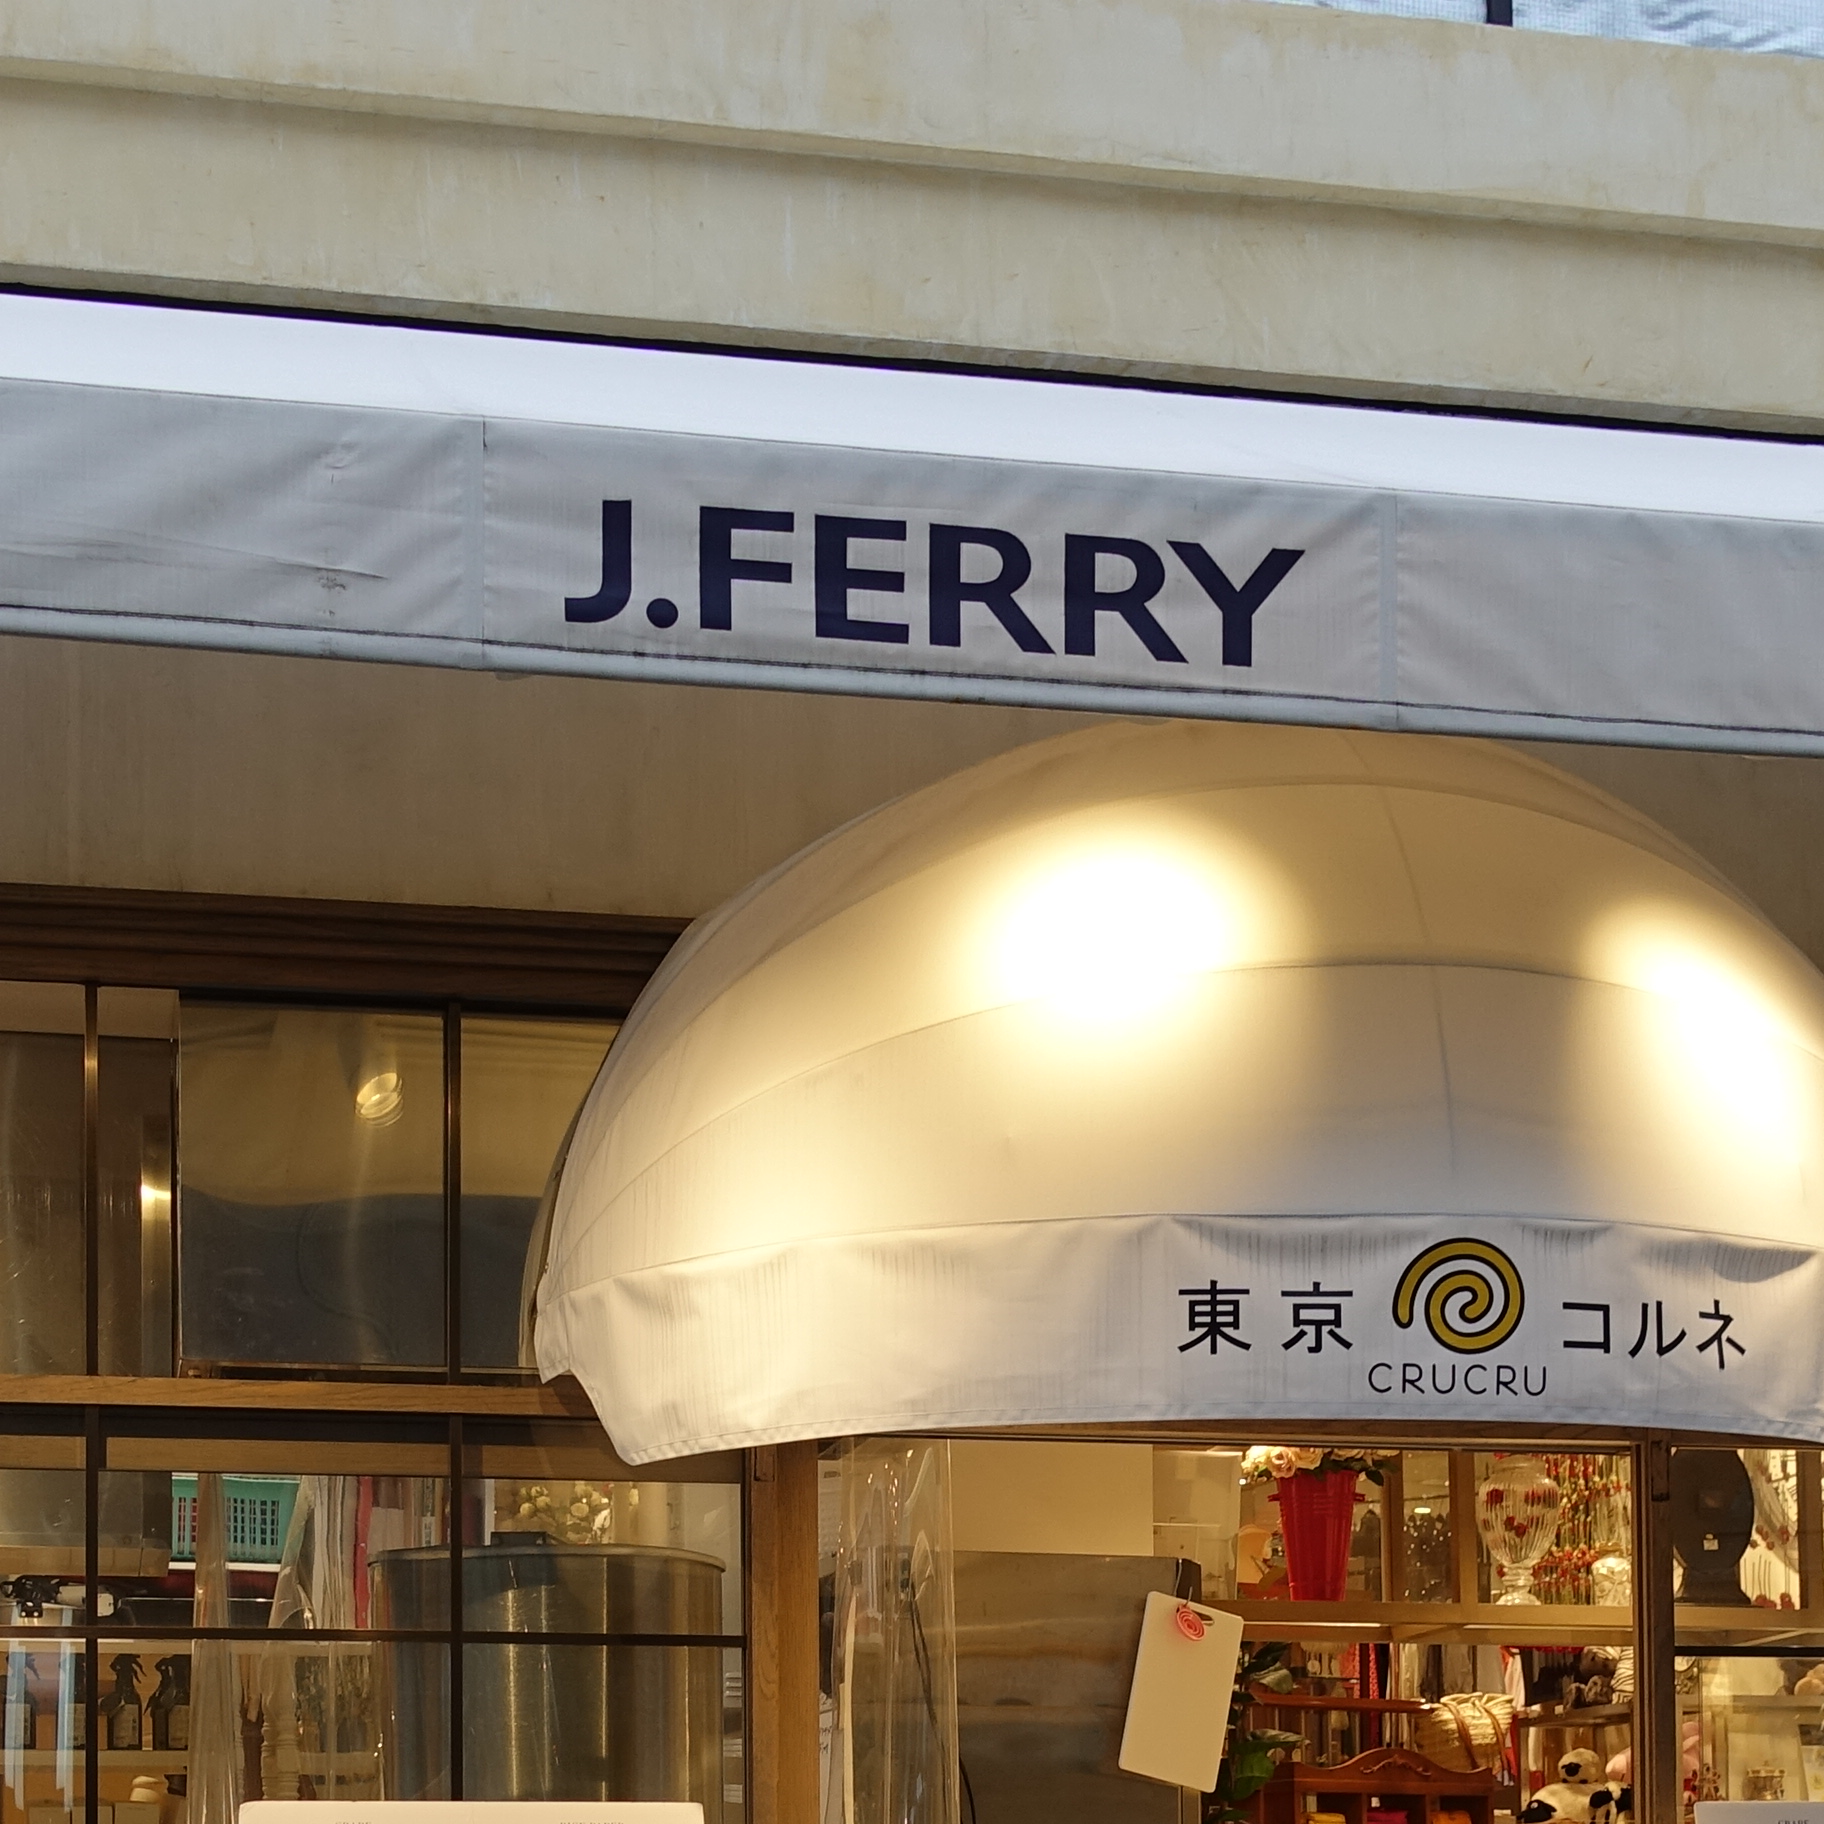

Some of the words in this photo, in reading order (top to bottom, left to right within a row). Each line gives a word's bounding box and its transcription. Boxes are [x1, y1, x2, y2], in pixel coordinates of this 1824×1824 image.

[564, 499, 1305, 667] J.FERRY
[1177, 1279, 1354, 1354] 東京
[1561, 1299, 1747, 1370] コルネ
[1368, 1362, 1547, 1397] CRUCRU
